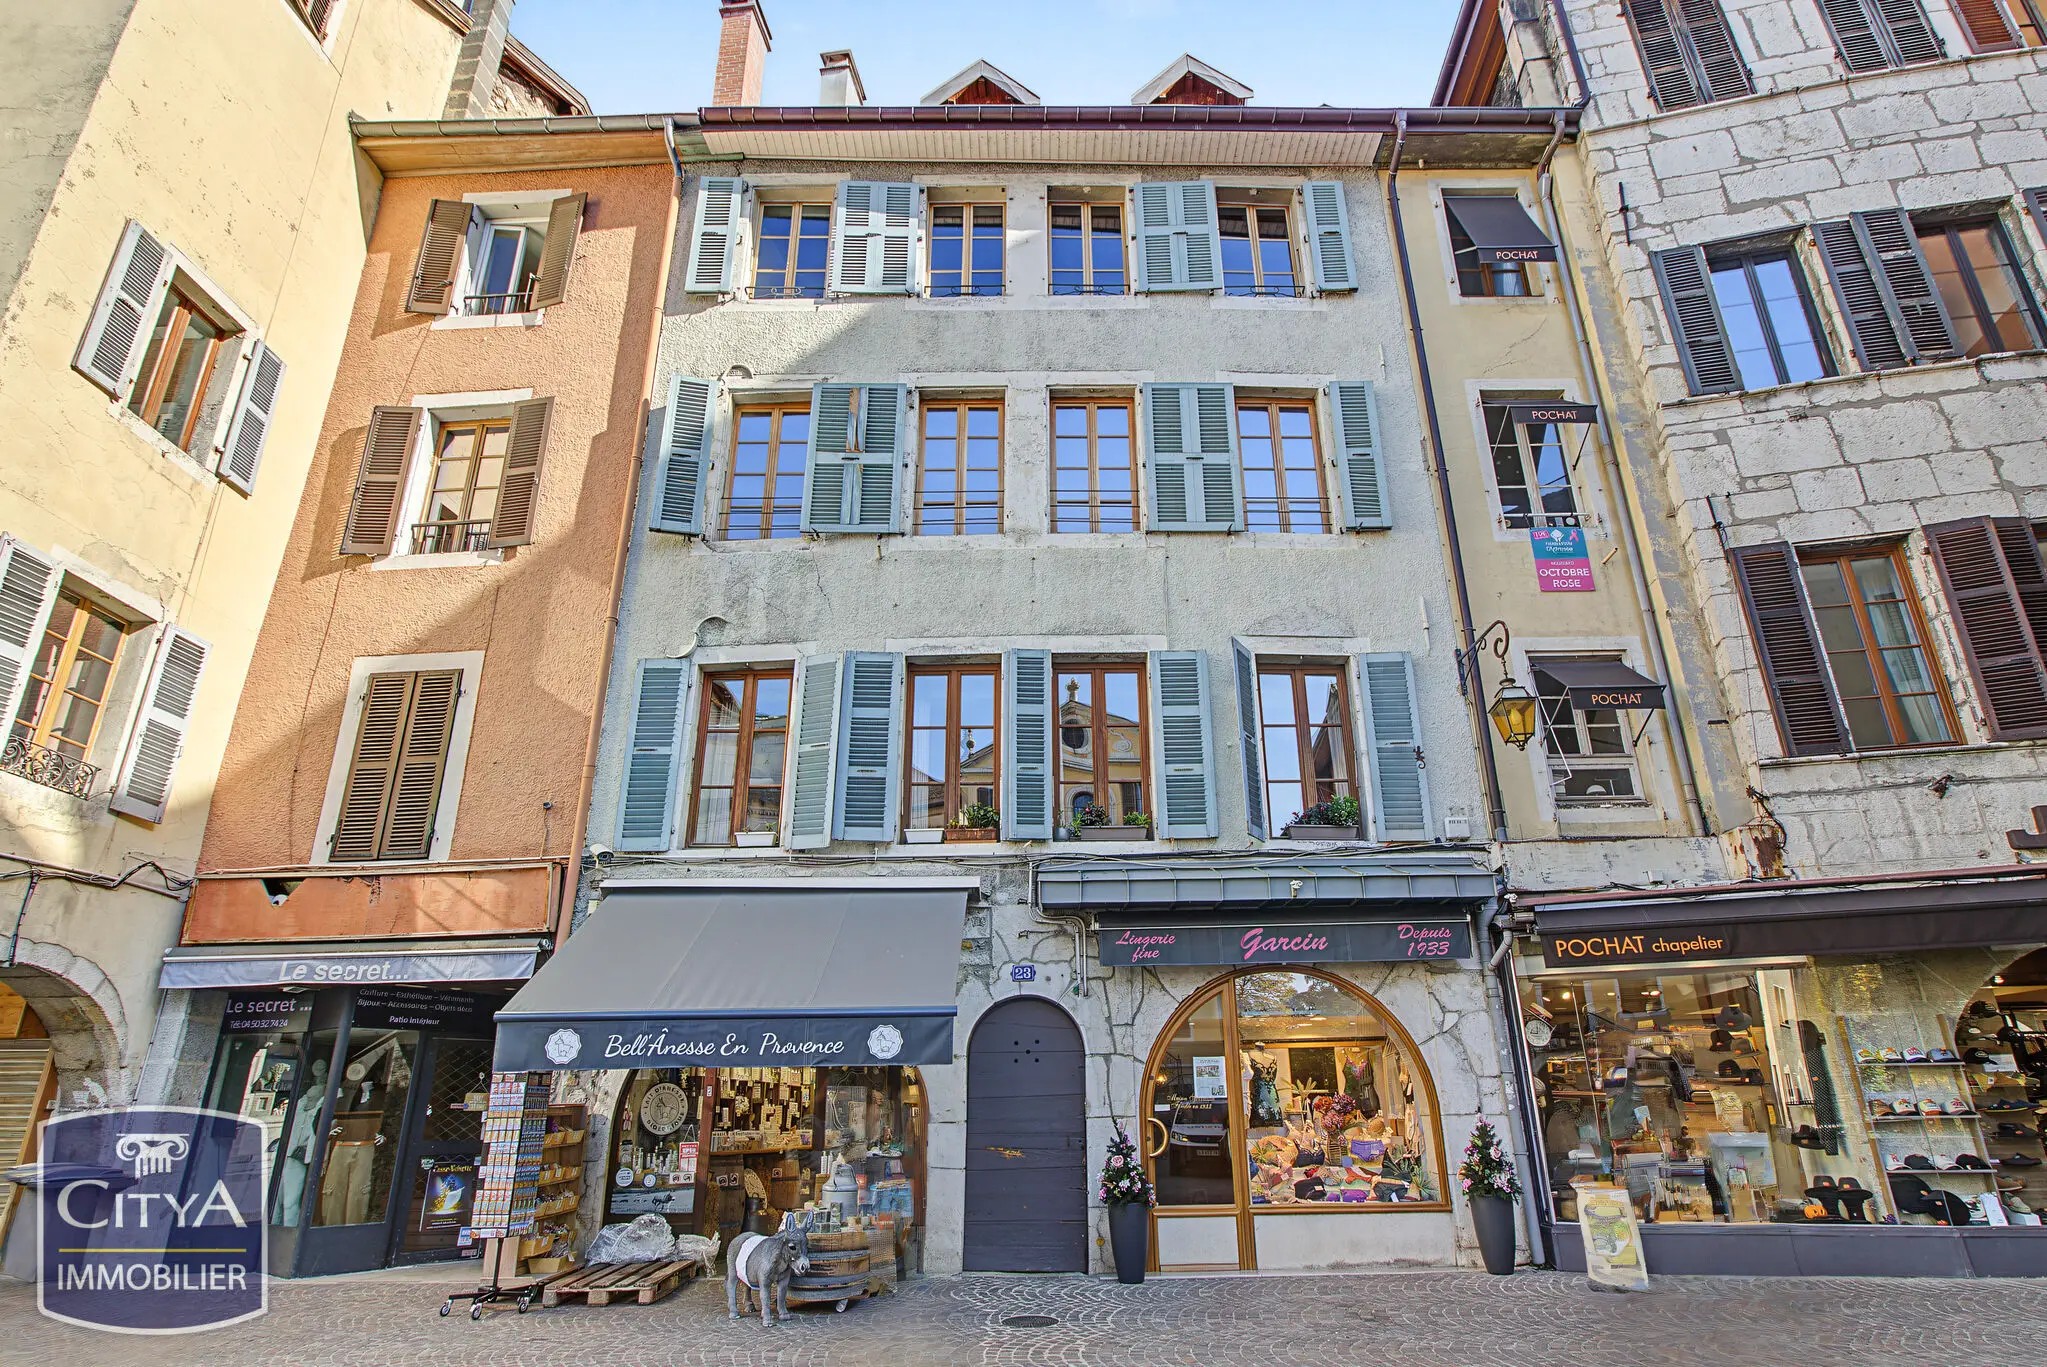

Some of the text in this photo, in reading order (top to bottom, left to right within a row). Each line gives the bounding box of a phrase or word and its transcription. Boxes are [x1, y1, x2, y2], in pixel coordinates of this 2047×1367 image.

[1495, 250, 1538, 260] POCHAT
[1531, 410, 1578, 420] POCHAT
[1539, 568, 1590, 577] OCTOBRE
[1552, 579, 1582, 588] ROSE
[1591, 693, 1642, 705] POCHAT
[1115, 930, 1176, 949] Lingerie
[1397, 924, 1452, 942] Depuis
[1240, 927, 1329, 960] Garcin
[1407, 941, 1450, 957] 1933
[1555, 935, 1724, 958] POCHAT chapelier
[1131, 947, 1160, 962] fine
[279, 960, 308, 981] Le
[1014, 967, 1032, 979] 23
[226, 999, 244, 1013] Le
[247, 998, 297, 1013] secret
[604, 1027, 845, 1058] Bell'Ânesse En Provence
